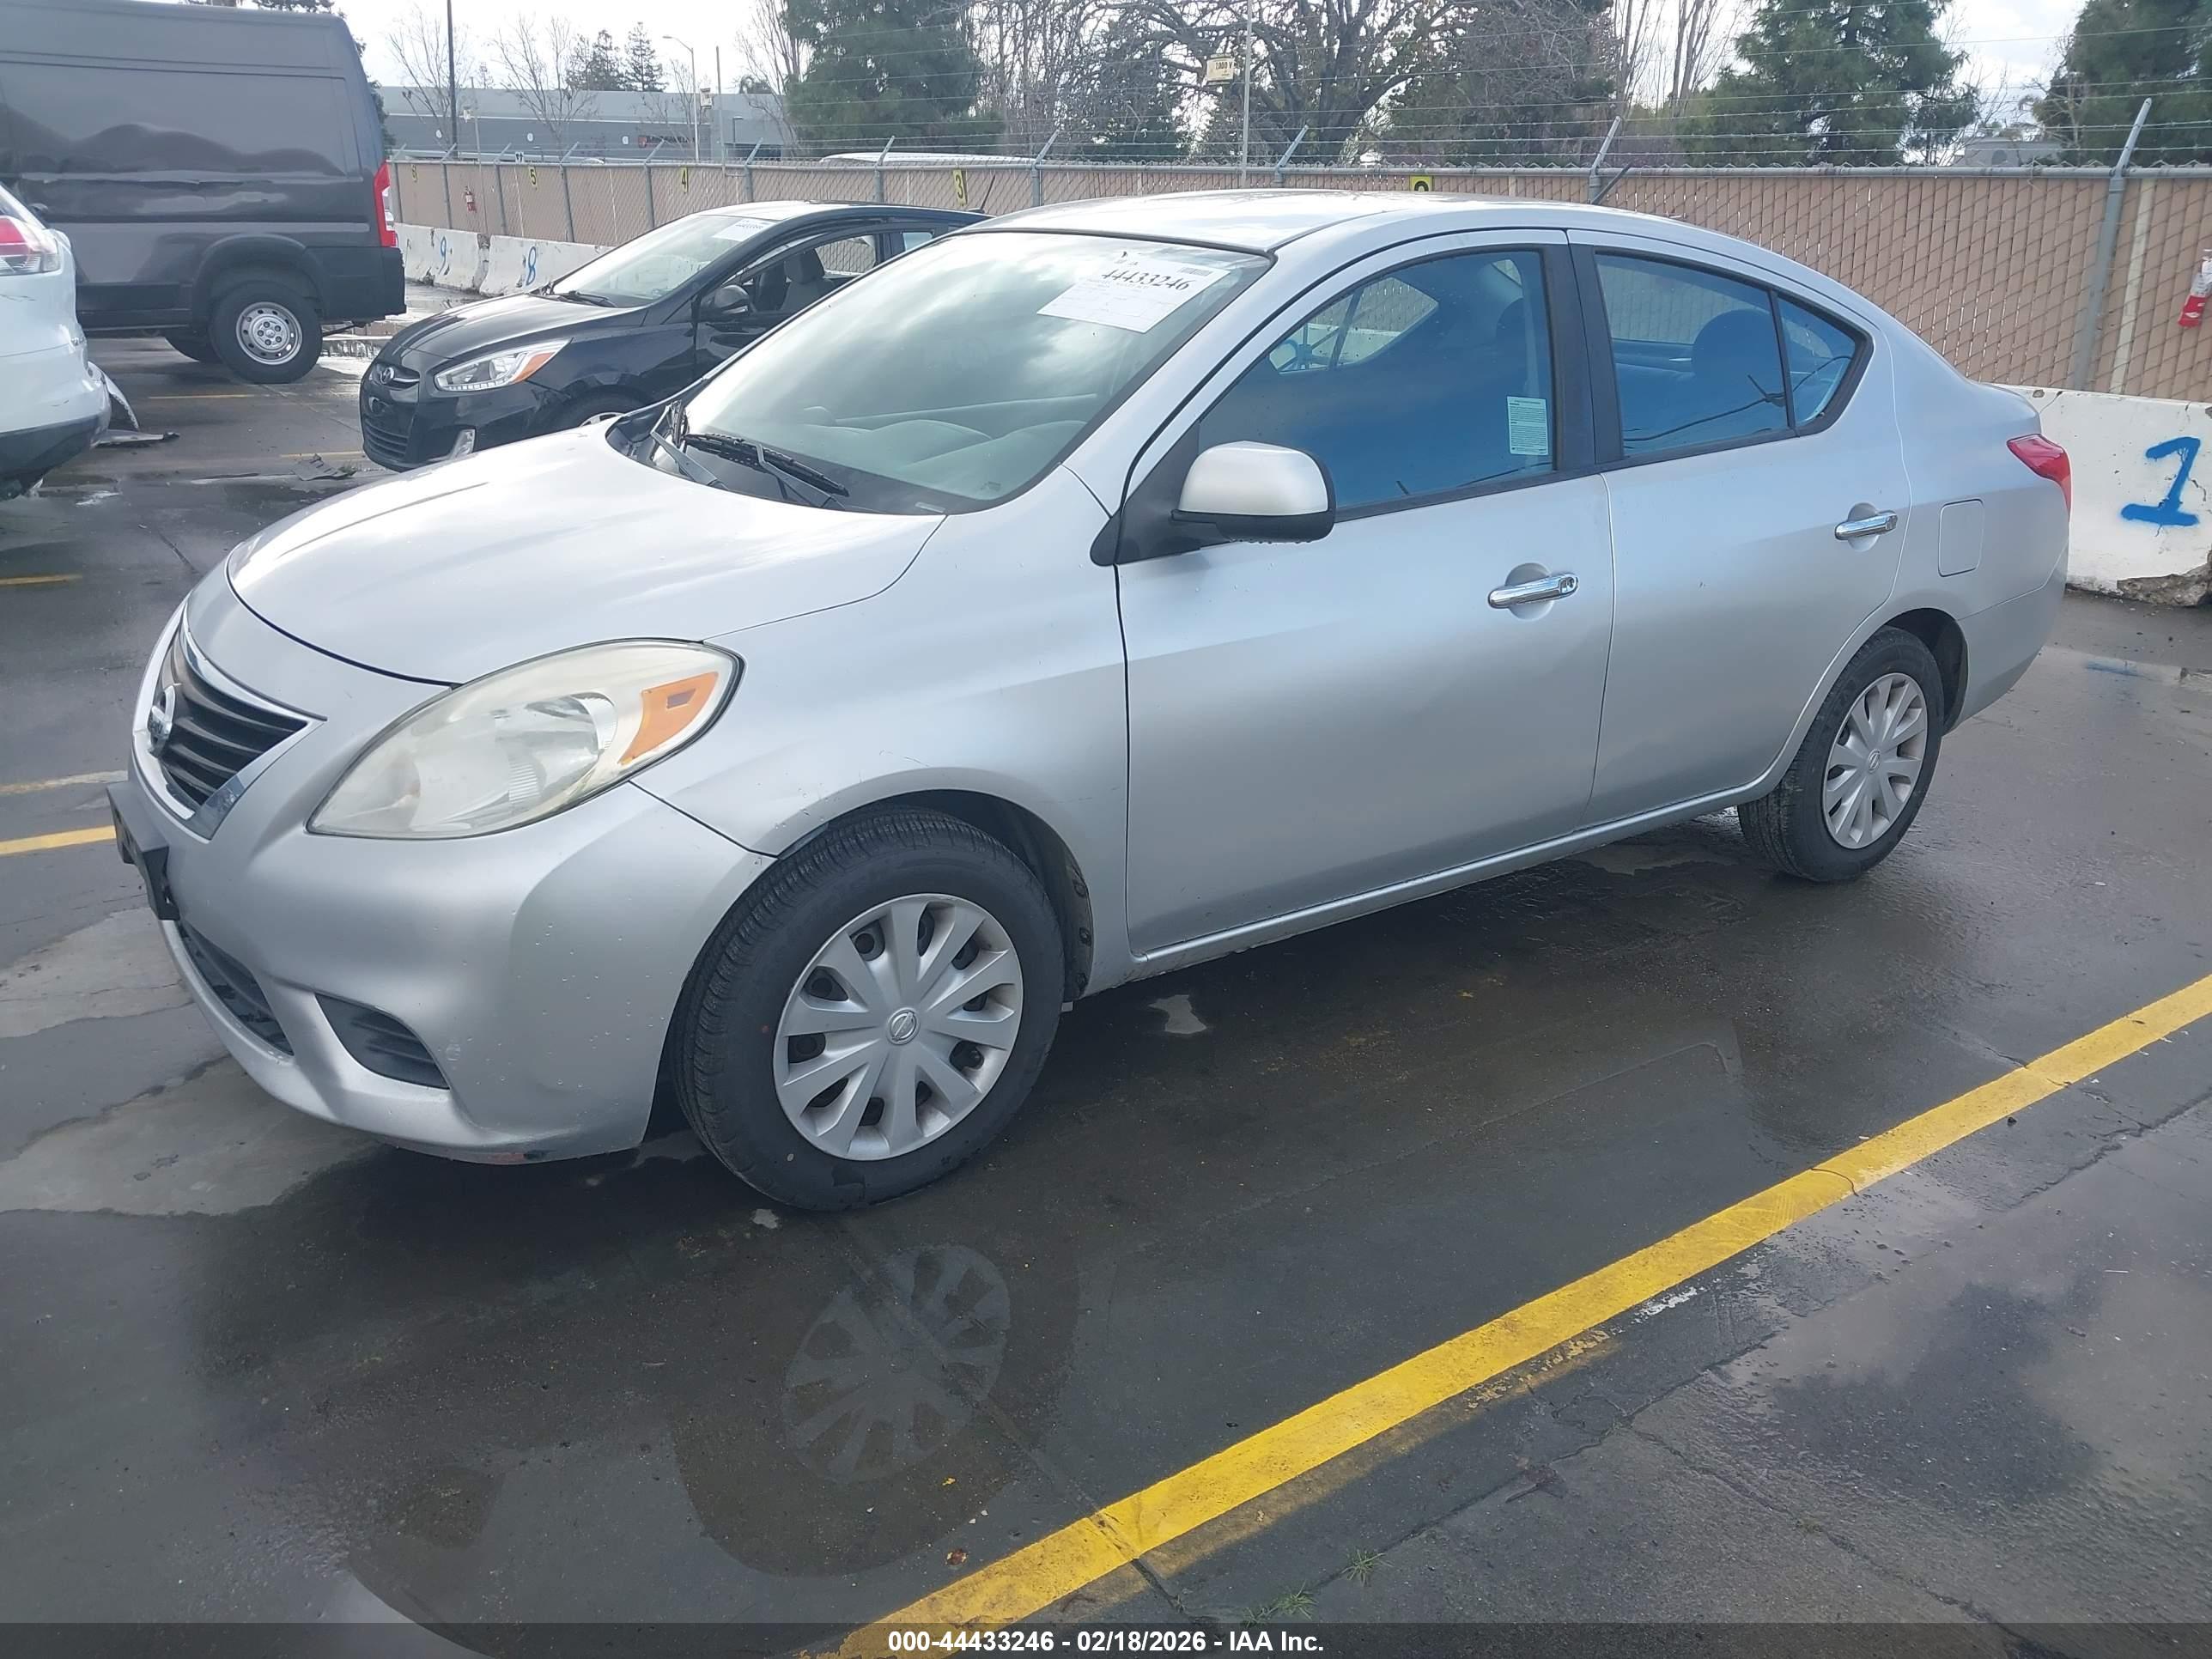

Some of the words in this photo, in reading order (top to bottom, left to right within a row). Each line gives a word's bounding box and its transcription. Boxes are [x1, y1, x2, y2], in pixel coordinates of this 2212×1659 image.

[530, 168, 537, 185] 5
[681, 168, 687, 190] 4
[955, 174, 963, 199] 3
[526, 246, 537, 286] 8
[1102, 269, 1196, 291] 44433246
[2120, 435, 2202, 527] 1
